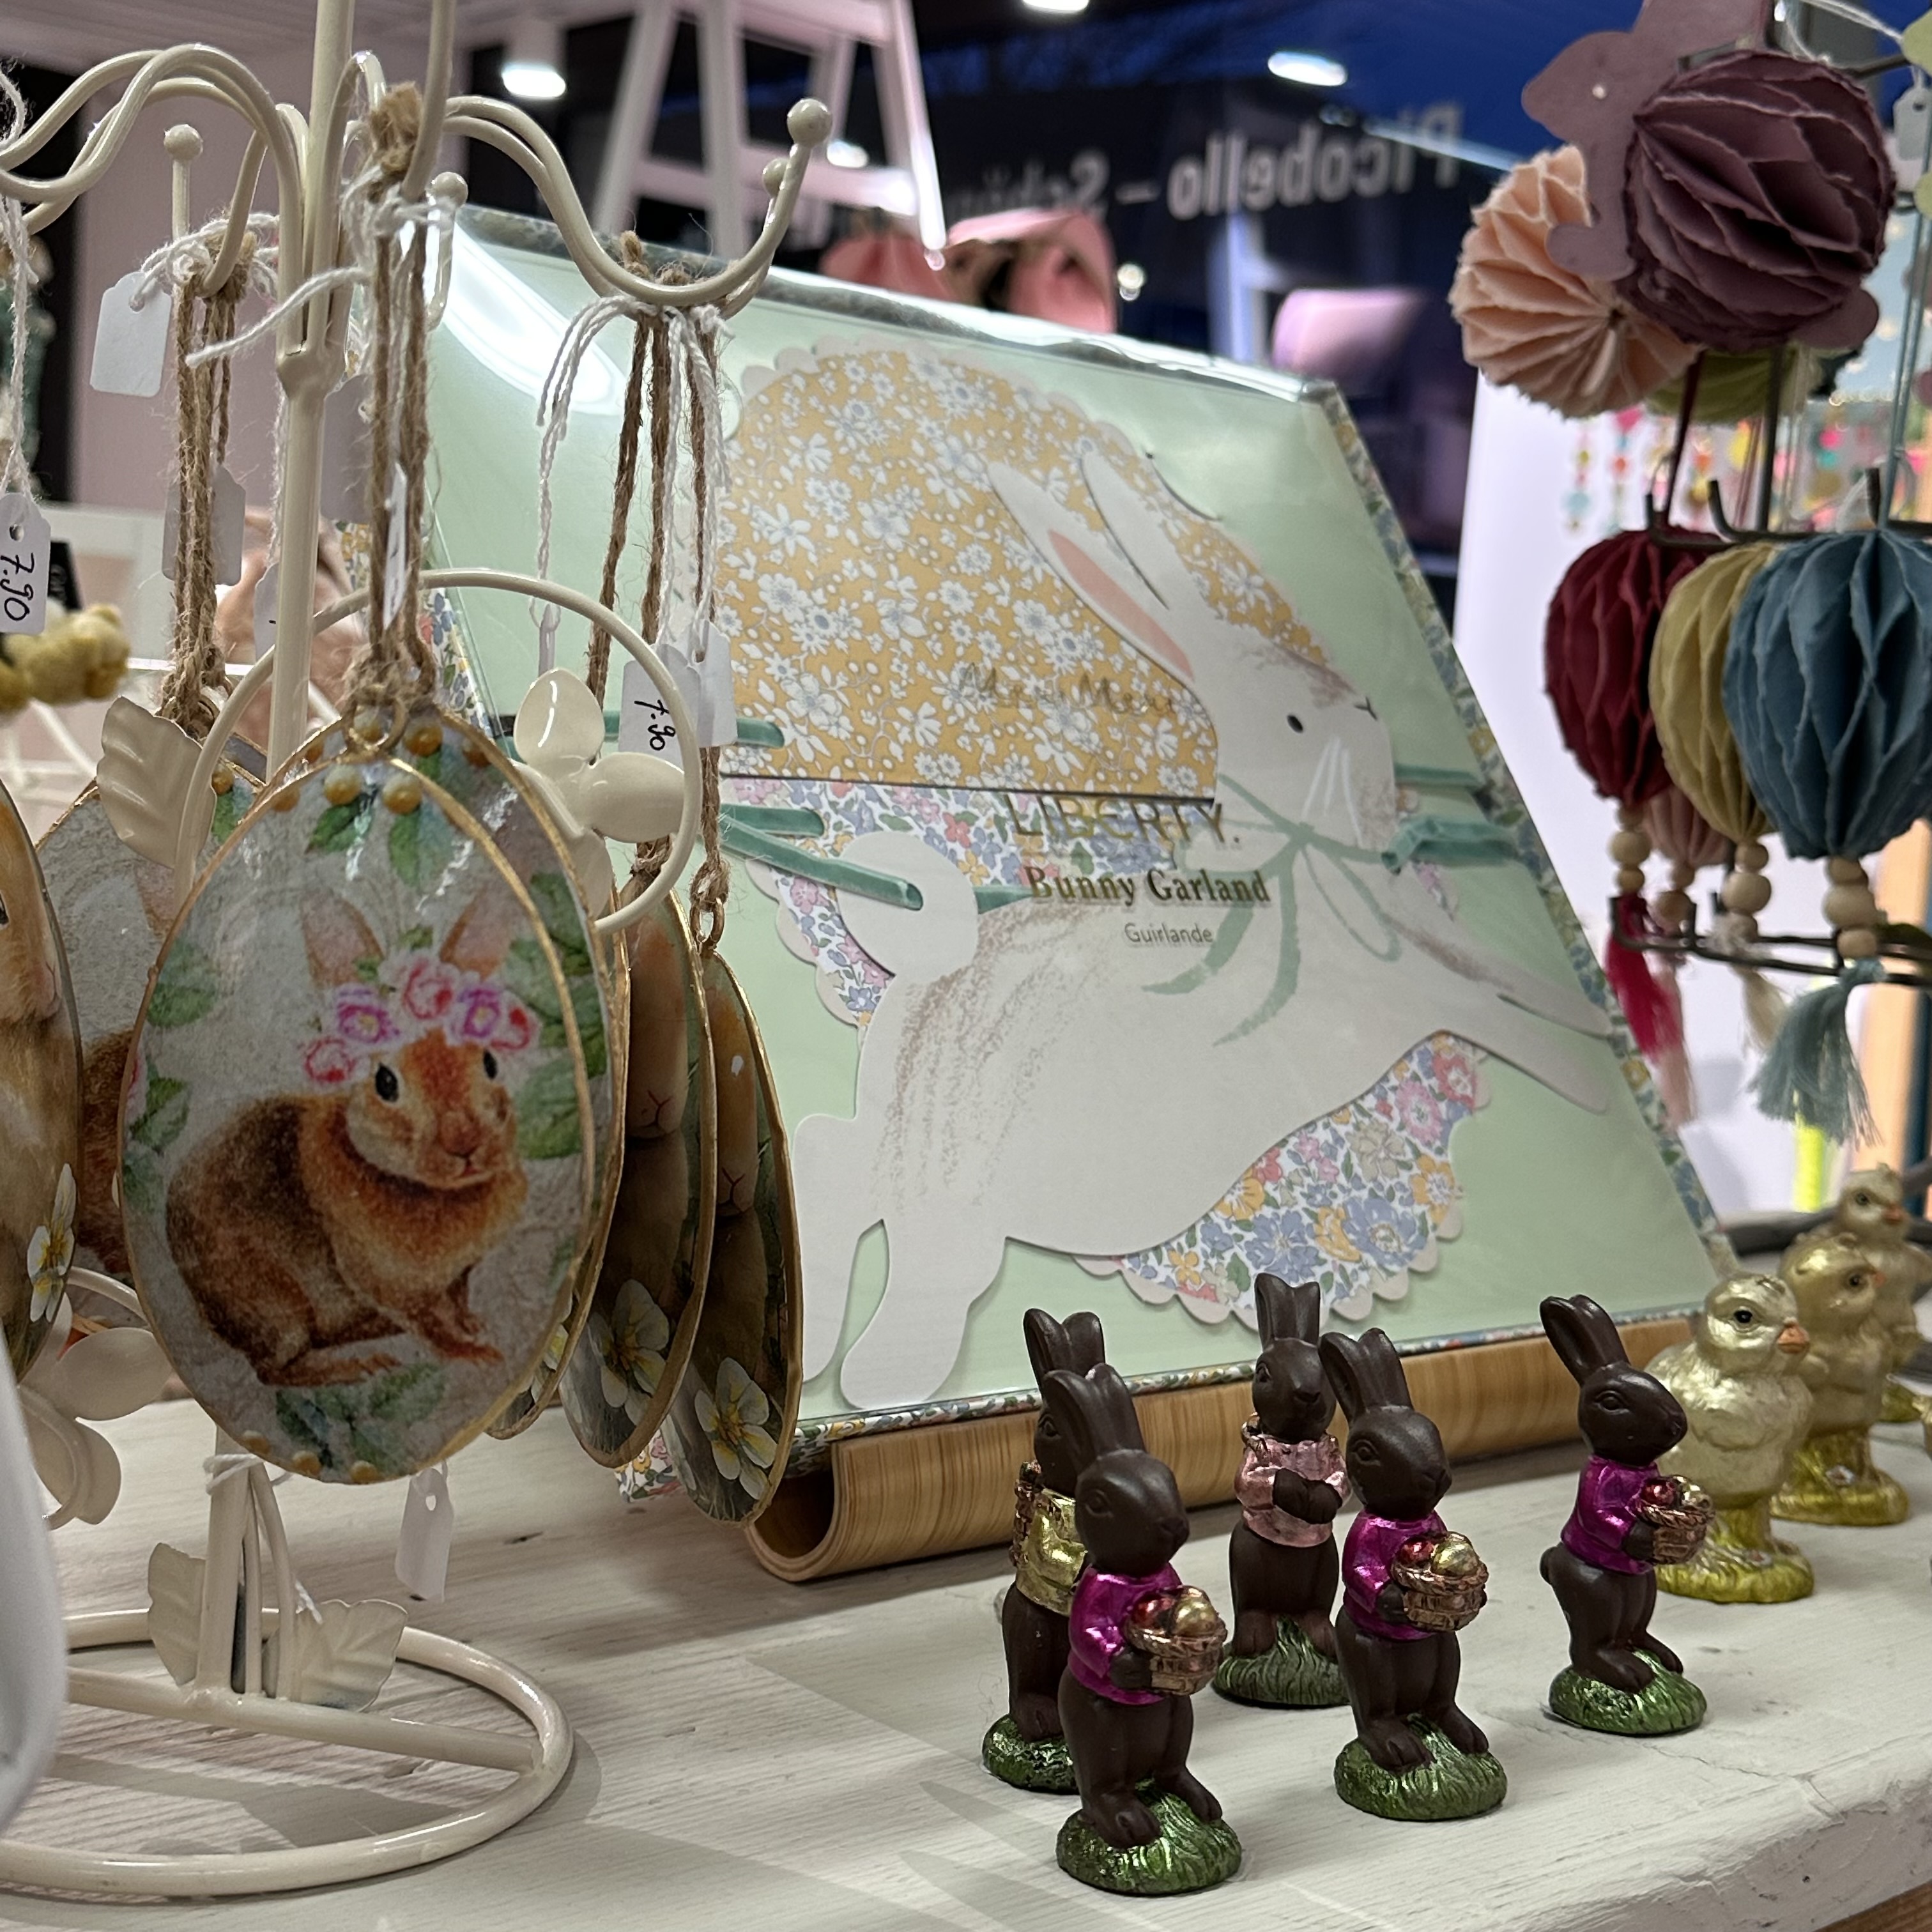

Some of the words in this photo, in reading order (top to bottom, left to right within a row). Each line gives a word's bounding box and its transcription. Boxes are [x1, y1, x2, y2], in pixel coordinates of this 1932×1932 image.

[1, 552, 34, 621] 7.90
[1025, 866, 1135, 907] Bunny
[1147, 870, 1270, 904] Garland
[1125, 923, 1213, 944] Guirlande
